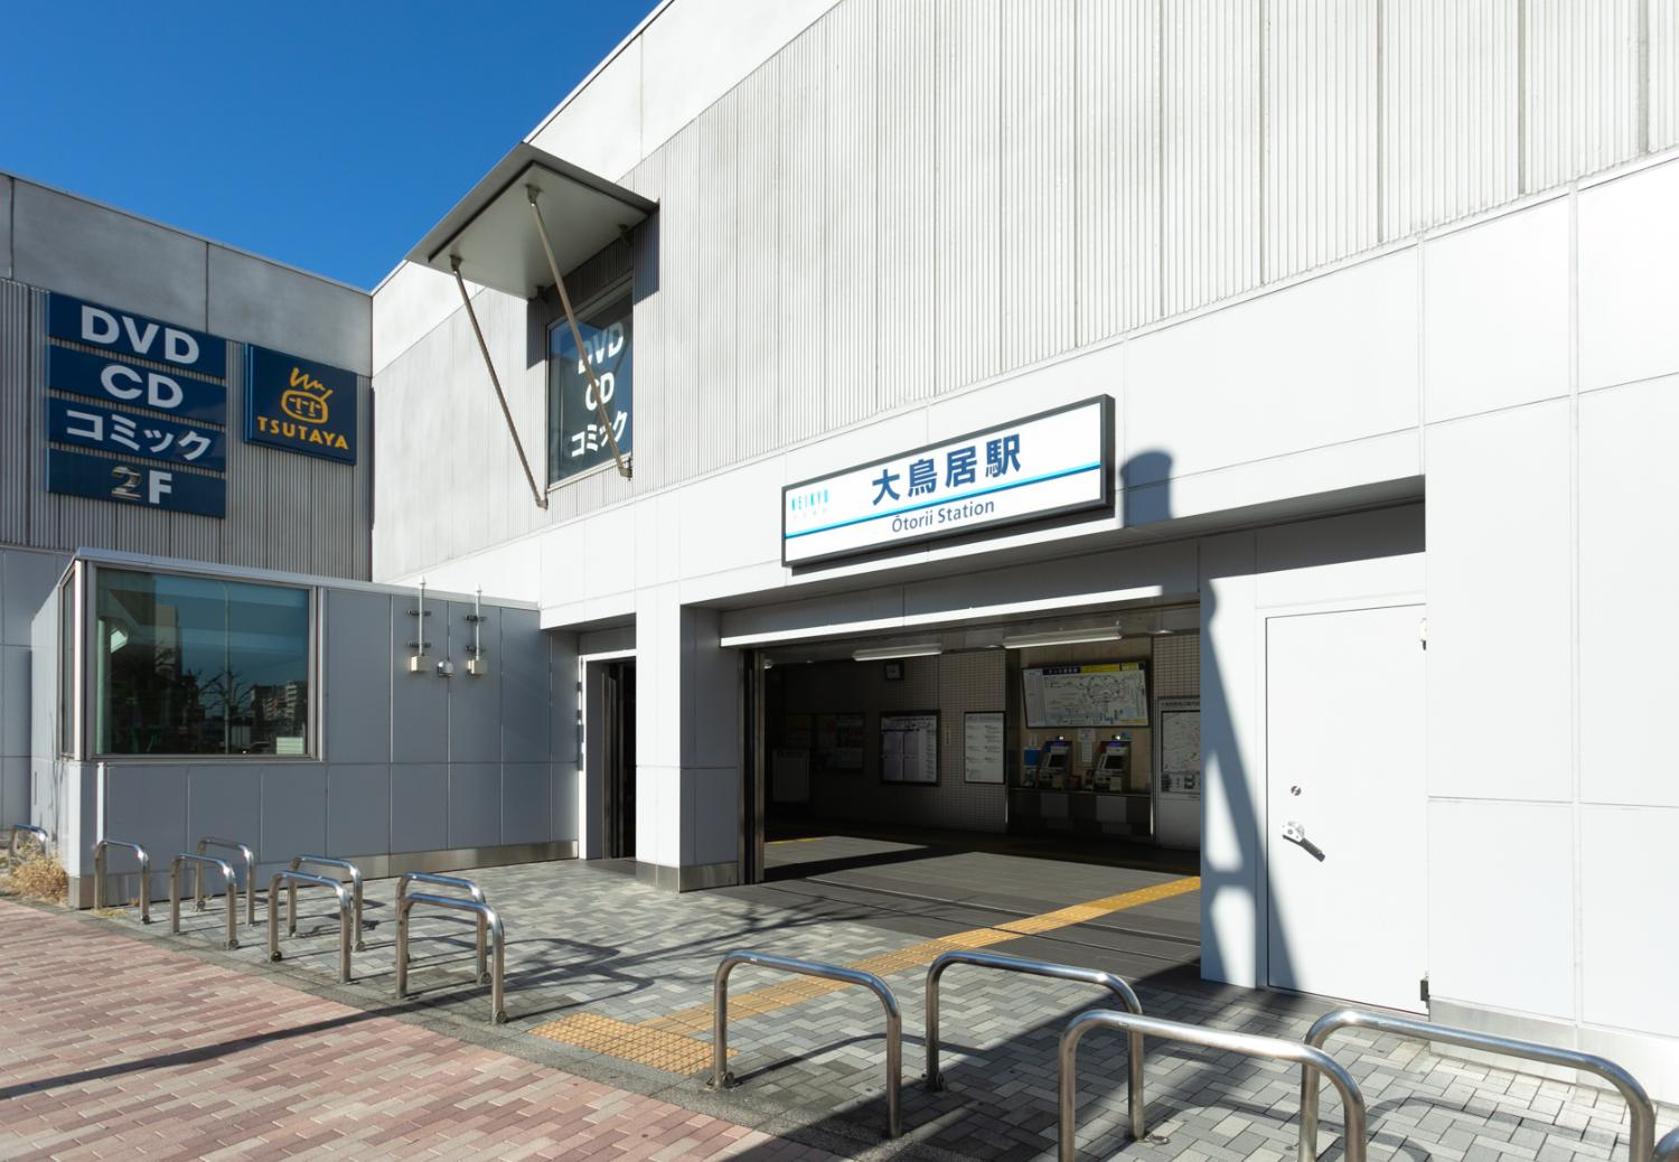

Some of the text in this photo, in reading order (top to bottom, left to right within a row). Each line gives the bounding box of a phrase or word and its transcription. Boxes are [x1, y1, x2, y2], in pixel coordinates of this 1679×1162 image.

[81, 306, 200, 364] DVD
[100, 364, 184, 409] CD
[585, 372, 615, 411] CD
[66, 409, 212, 461] コミック
[257, 416, 348, 450] TSUTAYA
[111, 465, 173, 504] 2F
[871, 433, 1021, 506] 大鳥居駅
[938, 499, 995, 524] Station
